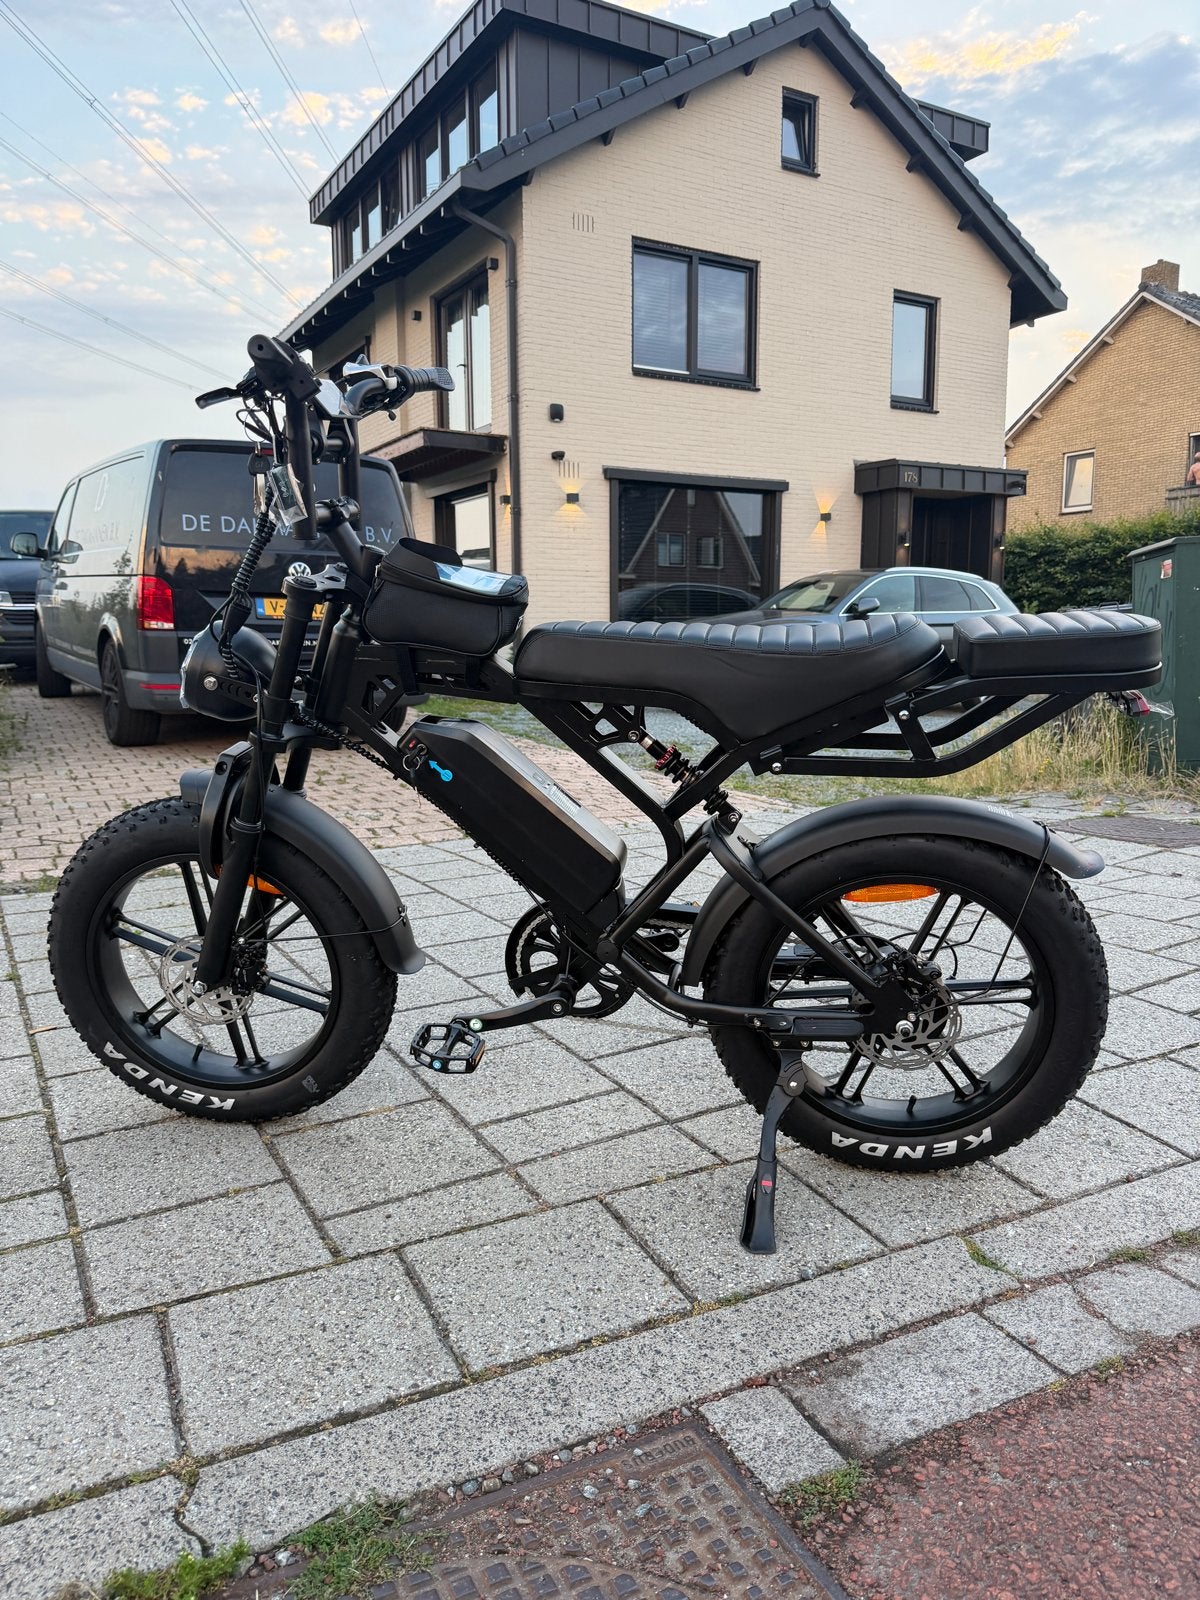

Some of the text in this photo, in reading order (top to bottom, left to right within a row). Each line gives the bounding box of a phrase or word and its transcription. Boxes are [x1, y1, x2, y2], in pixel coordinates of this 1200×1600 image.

[904, 471, 919, 483] 178
[182, 514, 211, 531] DE
[365, 526, 395, 544] B.V.
[103, 1041, 235, 1110] KENDA
[831, 1126, 993, 1159] KENDA
